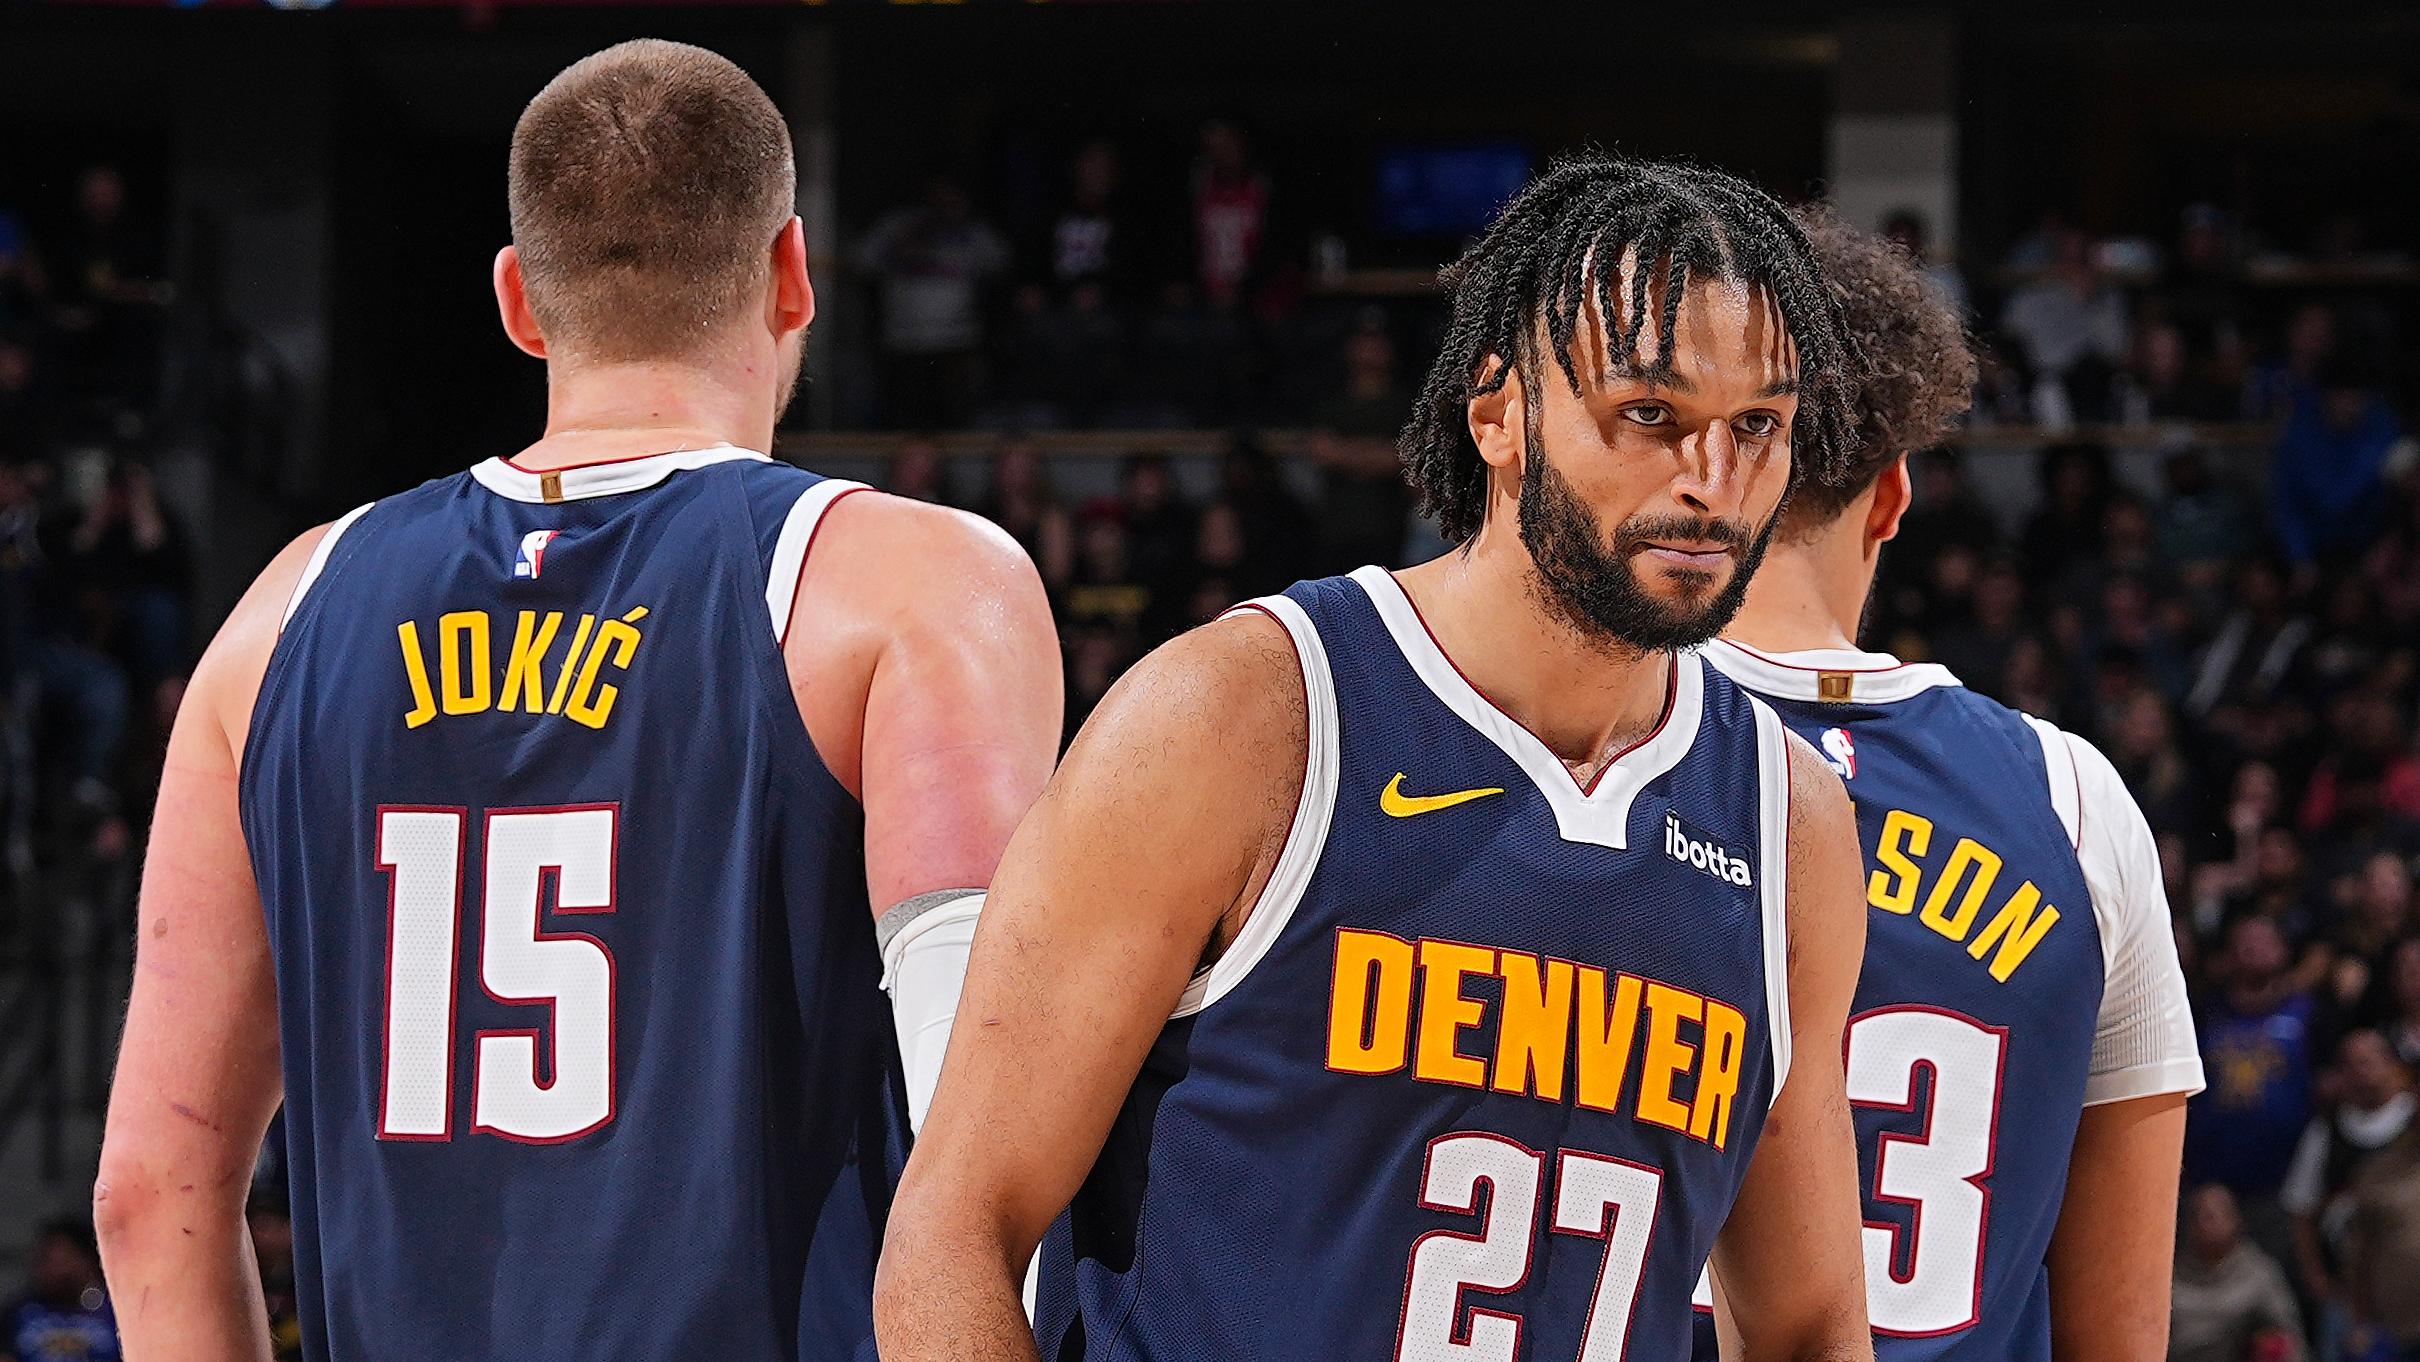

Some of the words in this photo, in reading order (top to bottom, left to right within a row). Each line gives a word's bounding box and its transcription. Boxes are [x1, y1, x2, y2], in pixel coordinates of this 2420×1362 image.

[397, 606, 649, 730] JOKIĆ
[1665, 815, 1752, 886] ibotta
[1850, 802, 2061, 984] SON
[374, 802, 620, 1145] 15
[1325, 926, 1748, 1153] DENVER
[1394, 1130, 1665, 1362] 27
[1842, 1003, 2009, 1338] 3
